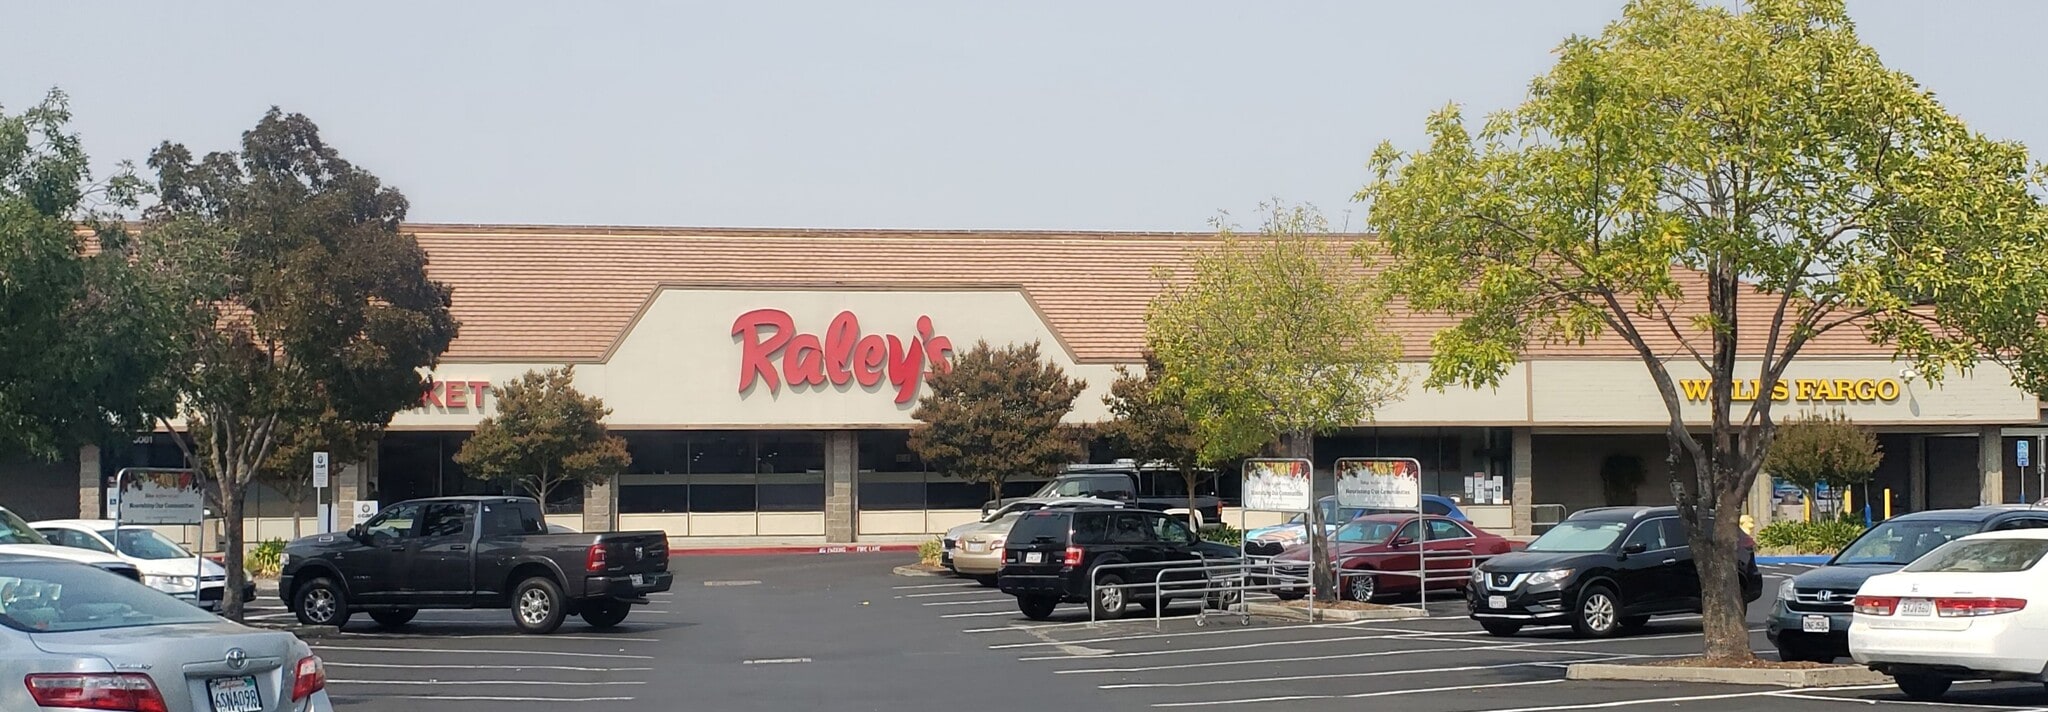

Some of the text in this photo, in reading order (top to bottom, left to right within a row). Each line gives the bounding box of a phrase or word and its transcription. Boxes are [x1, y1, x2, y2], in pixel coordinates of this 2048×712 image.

[732, 309, 952, 403] Raley's
[420, 381, 490, 408] KET
[1680, 379, 1899, 400] WLS FARGO
